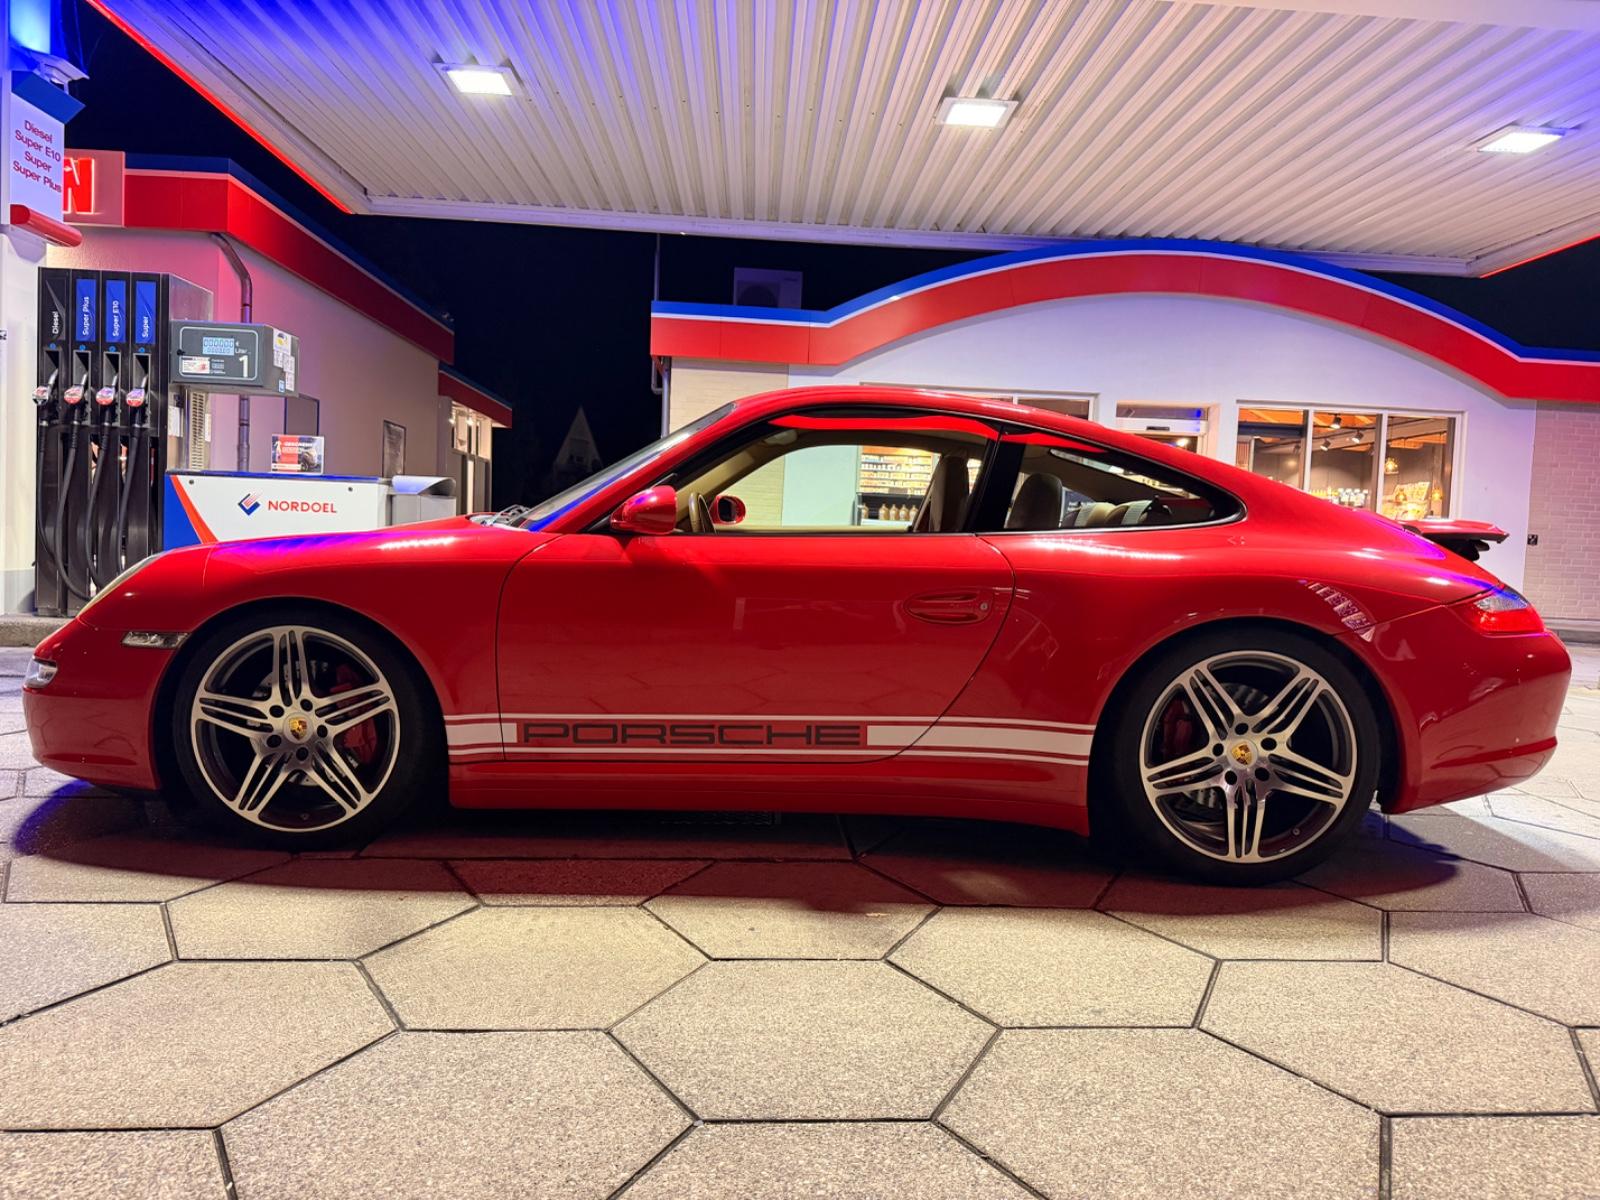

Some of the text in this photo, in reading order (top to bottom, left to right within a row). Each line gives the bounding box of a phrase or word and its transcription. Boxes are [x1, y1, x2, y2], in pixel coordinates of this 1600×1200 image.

[24, 119, 53, 144] Diesel
[15, 129, 62, 162] Super E10
[24, 150, 52, 172] Super
[13, 160, 62, 193] Super Plus
[82, 296, 90, 336] Super Plus
[112, 315, 121, 337] Super
[142, 316, 150, 338] Super
[239, 355, 248, 378] 1
[268, 500, 337, 514] NORDOEL
[523, 722, 861, 746] PORSCHE
